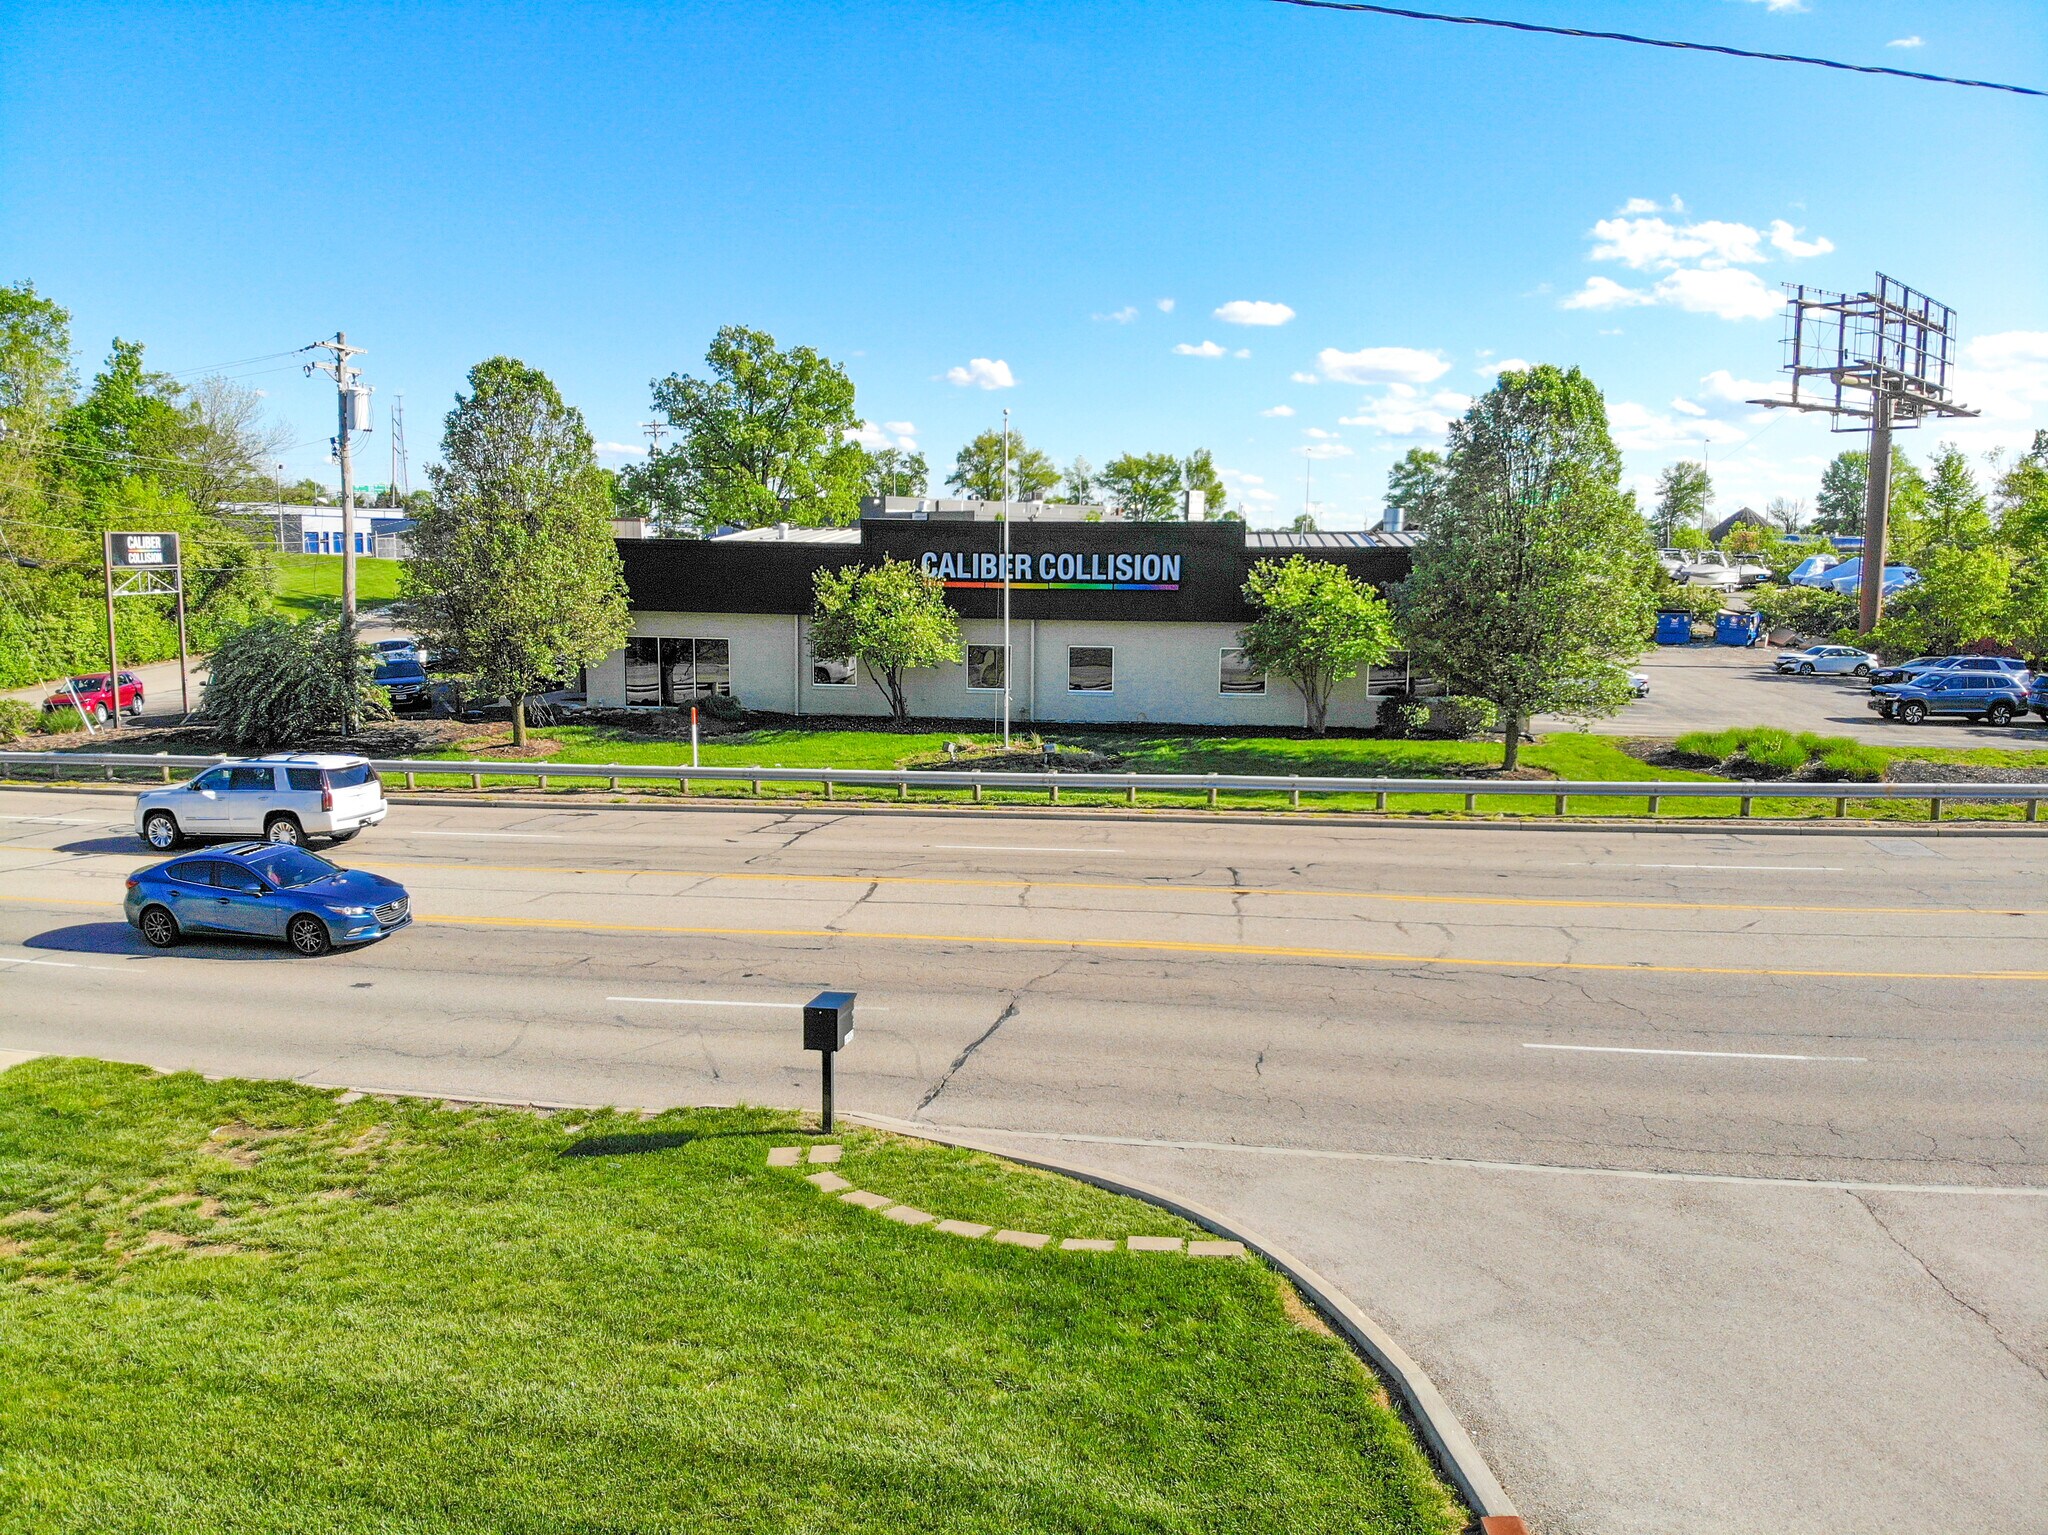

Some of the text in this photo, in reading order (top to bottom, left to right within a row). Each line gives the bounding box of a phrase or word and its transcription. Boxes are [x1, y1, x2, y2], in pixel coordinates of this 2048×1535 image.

[127, 536, 161, 549] CALIBER
[128, 552, 163, 564] COLLISION
[921, 552, 1181, 581] CALIBER COLLISION
